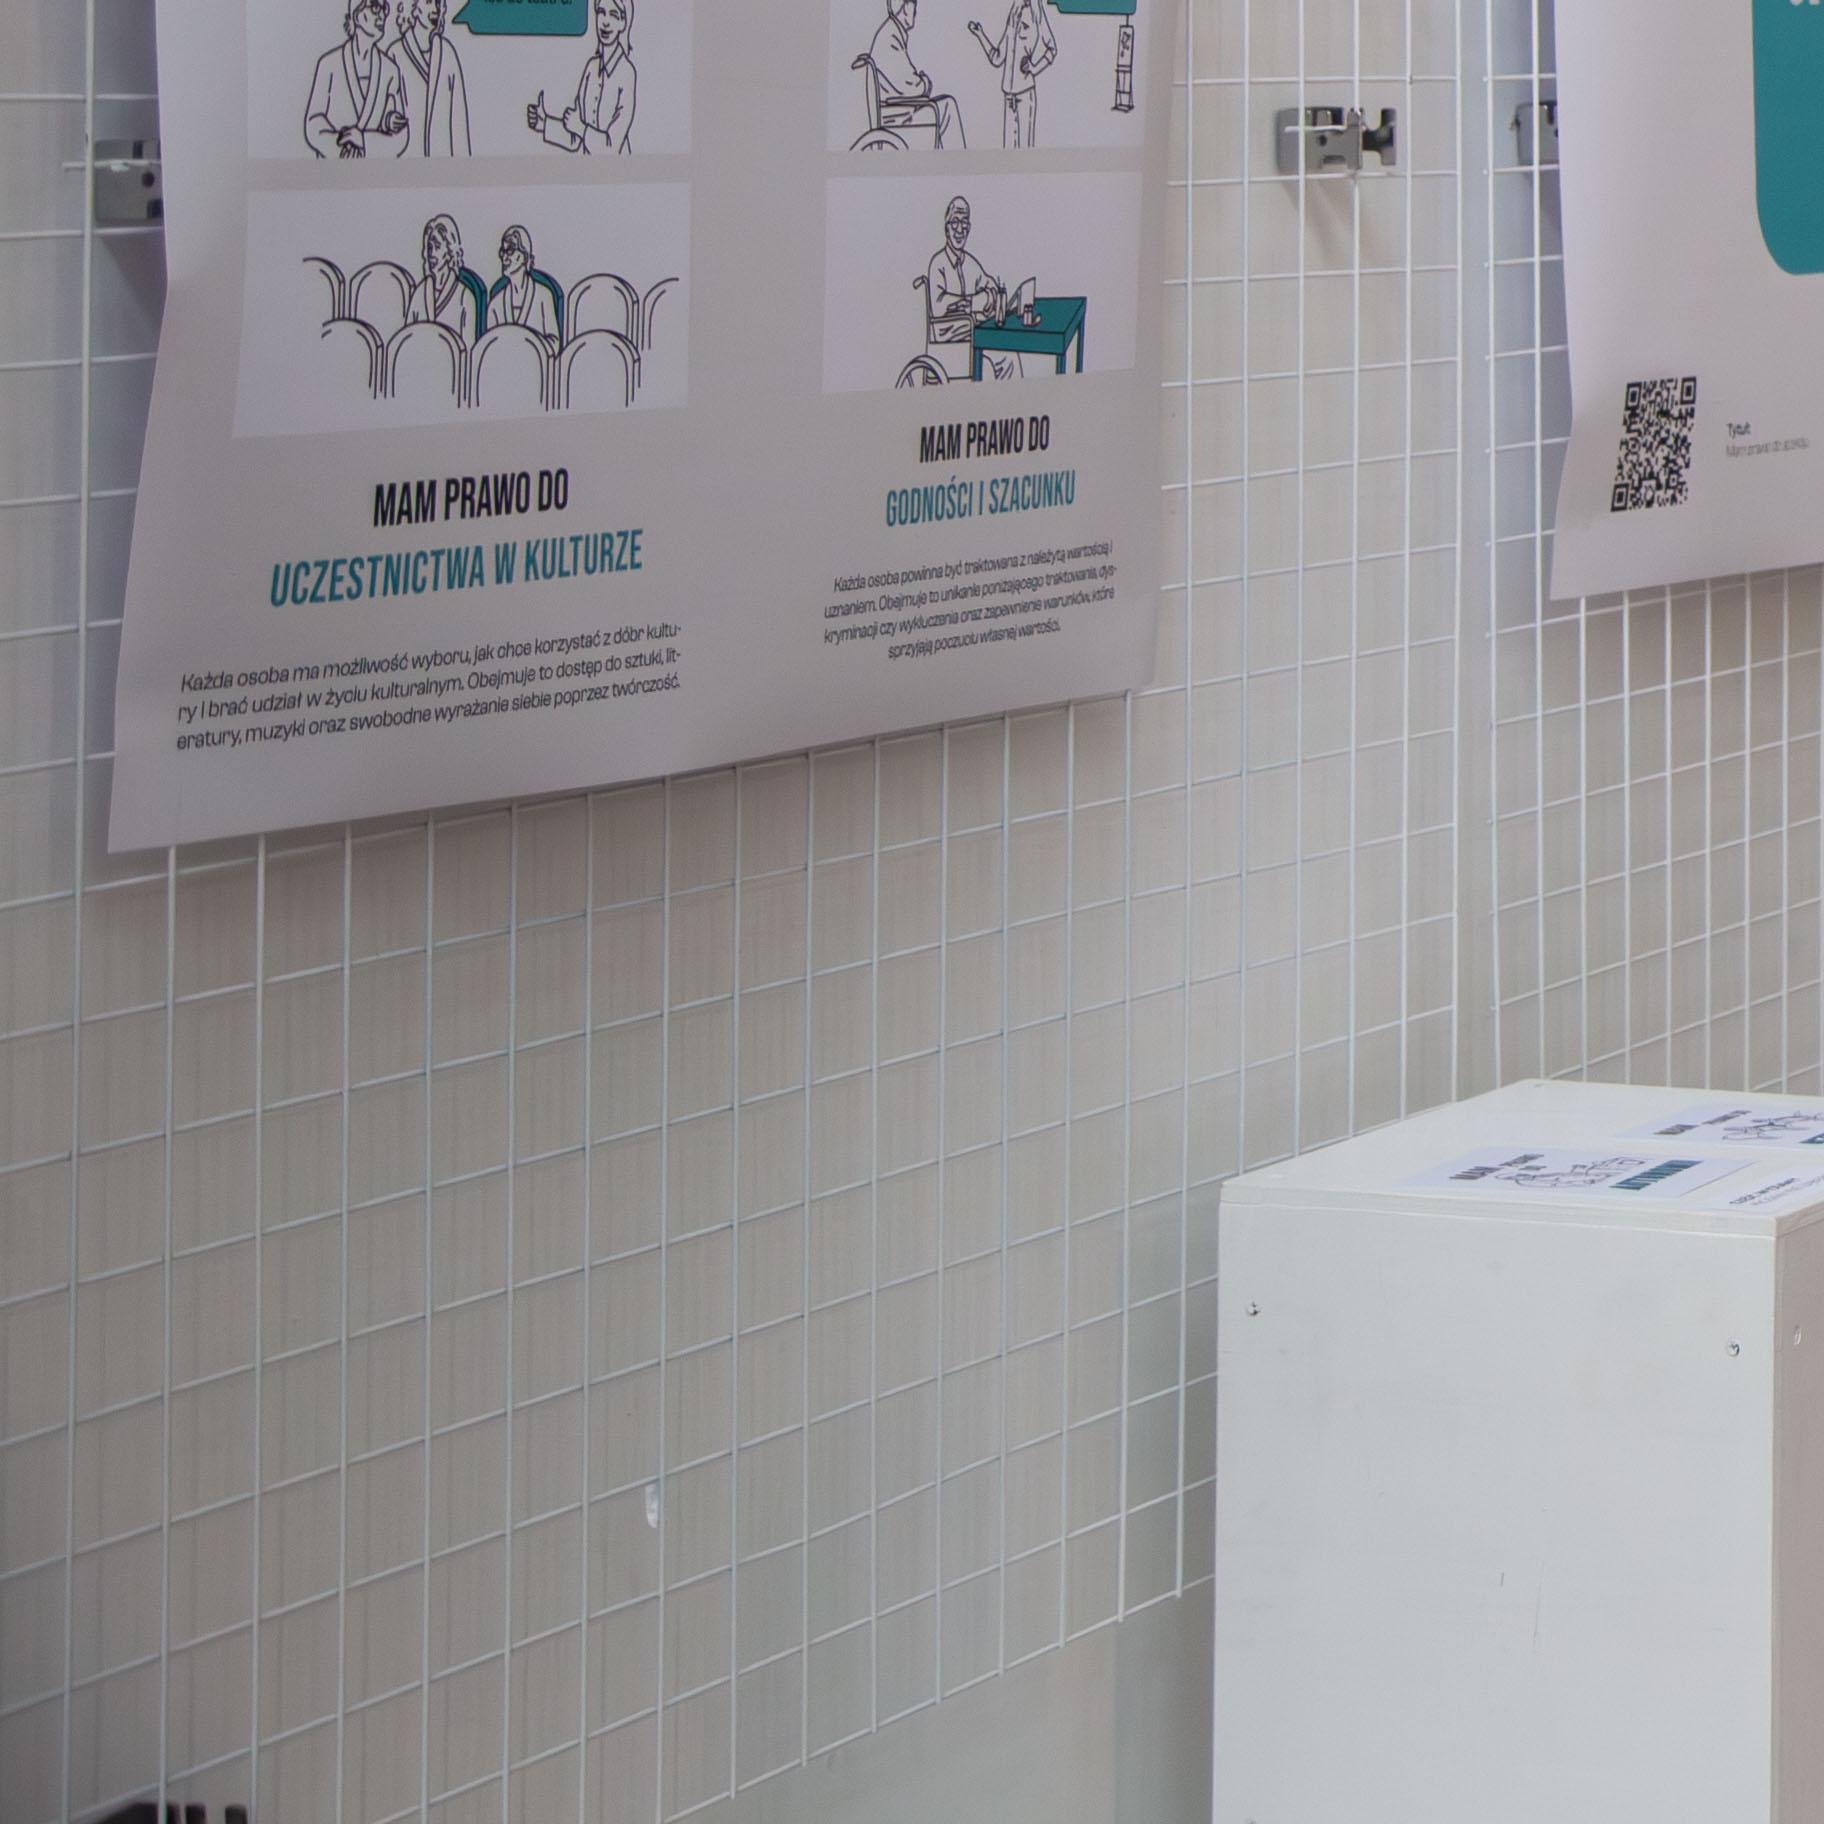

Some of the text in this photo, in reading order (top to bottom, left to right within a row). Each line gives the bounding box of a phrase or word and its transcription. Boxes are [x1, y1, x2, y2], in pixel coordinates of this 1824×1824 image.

[920, 414, 1050, 463] MAM PRAWO DO
[373, 468, 568, 528] MAM PRAWO DO
[886, 469, 1076, 527] GODNOŚCI I SZACUNKU
[270, 529, 643, 608] UCZESTNICTWA W KULTURZE
[834, 573, 866, 592] Każda
[868, 570, 899, 588] osoba
[900, 565, 943, 586] powinna
[178, 647, 681, 724] ry i brać udział w życiu kulturalnym. Obejmuje to dostęp do sztuki, lit-
[181, 622, 682, 692] Każda osoba ma możliwość wyboru, jak chce korzystać z dóbr kultu-
[177, 672, 680, 750] eratury, muzyki oraz swobodne wyrażanie siebie poprzez twórczość.
